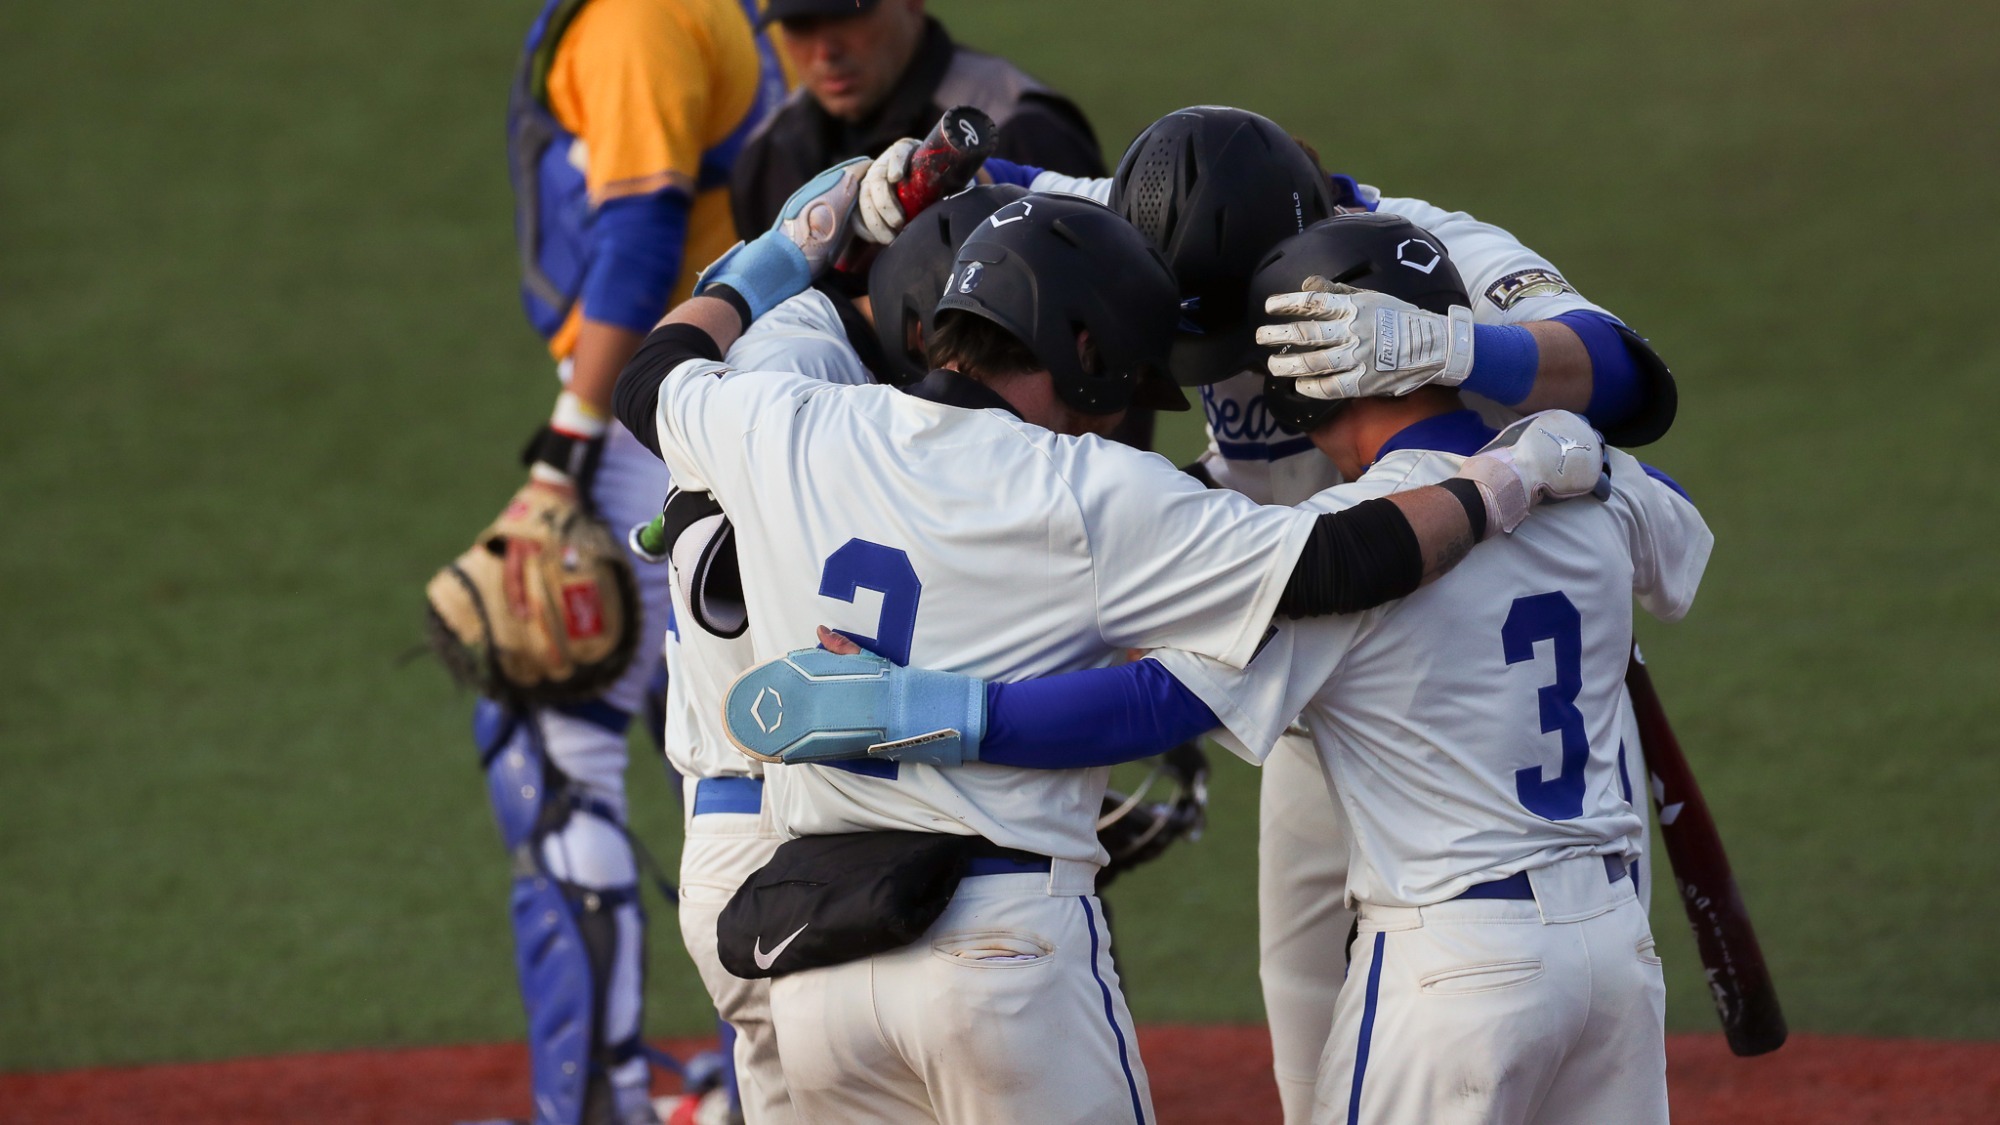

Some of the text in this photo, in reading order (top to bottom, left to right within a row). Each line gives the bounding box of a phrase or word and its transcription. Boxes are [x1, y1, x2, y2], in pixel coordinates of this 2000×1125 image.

[960, 267, 976, 289] 2
[1378, 310, 1394, 367] Franklin
[1199, 384, 1278, 439] Bea
[815, 537, 922, 780] 2
[1501, 590, 1590, 821] 3
